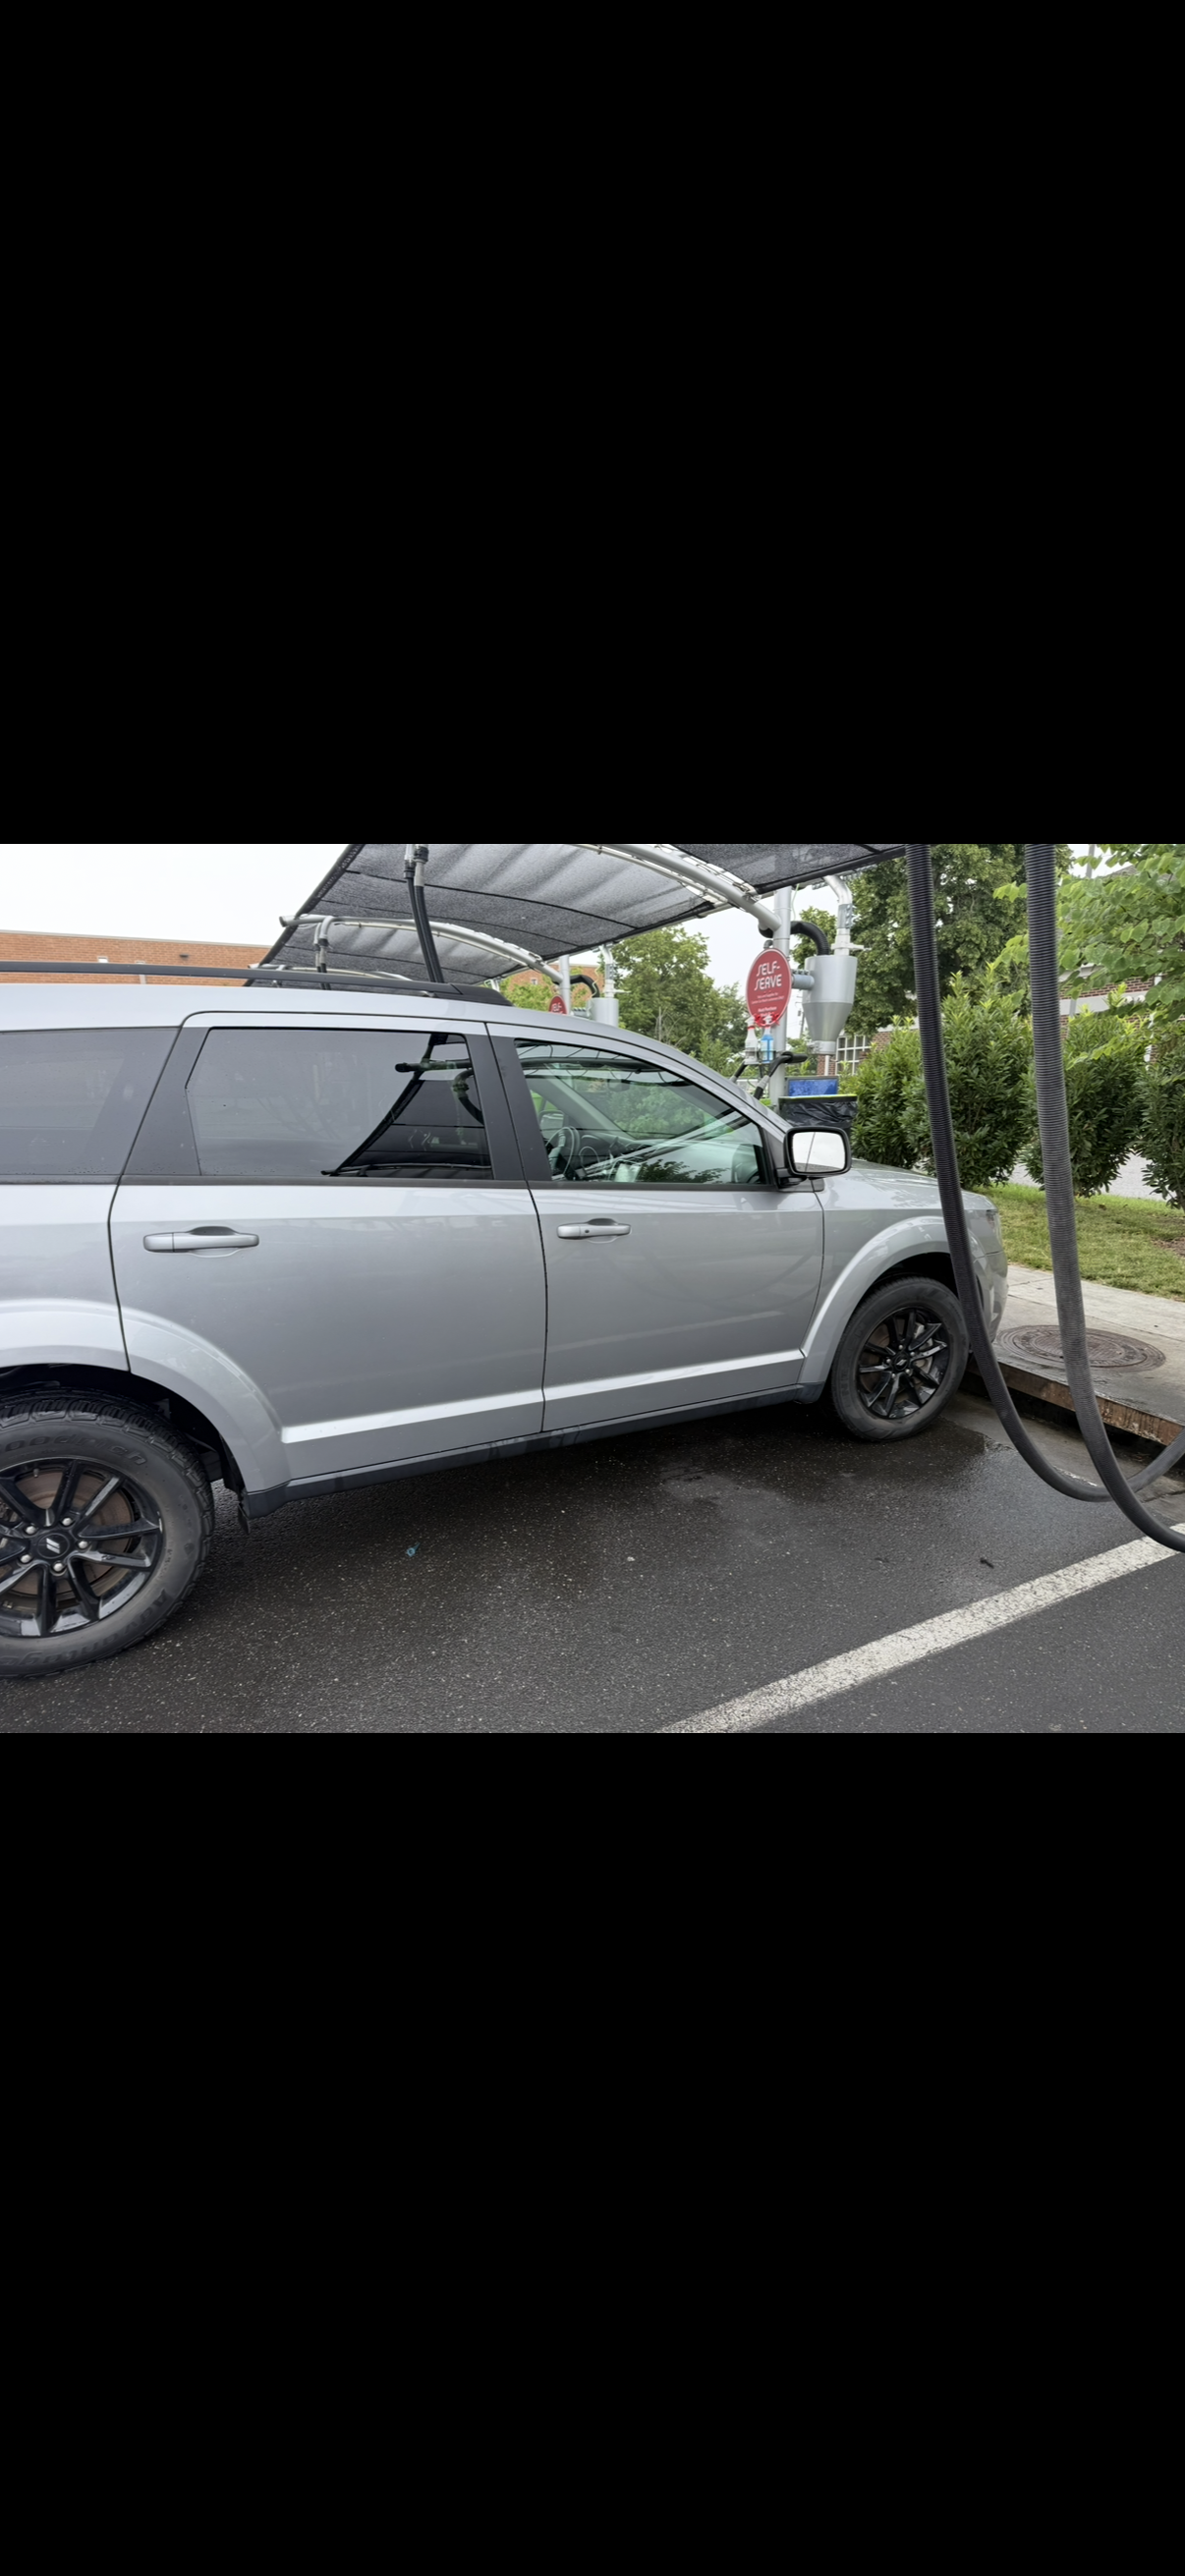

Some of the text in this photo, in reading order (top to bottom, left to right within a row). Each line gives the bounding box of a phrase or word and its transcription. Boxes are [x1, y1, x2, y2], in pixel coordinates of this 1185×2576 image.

[757, 961, 780, 978] SELF-
[754, 974, 782, 991] SERVE
[5, 1433, 148, 1466] oodrich
